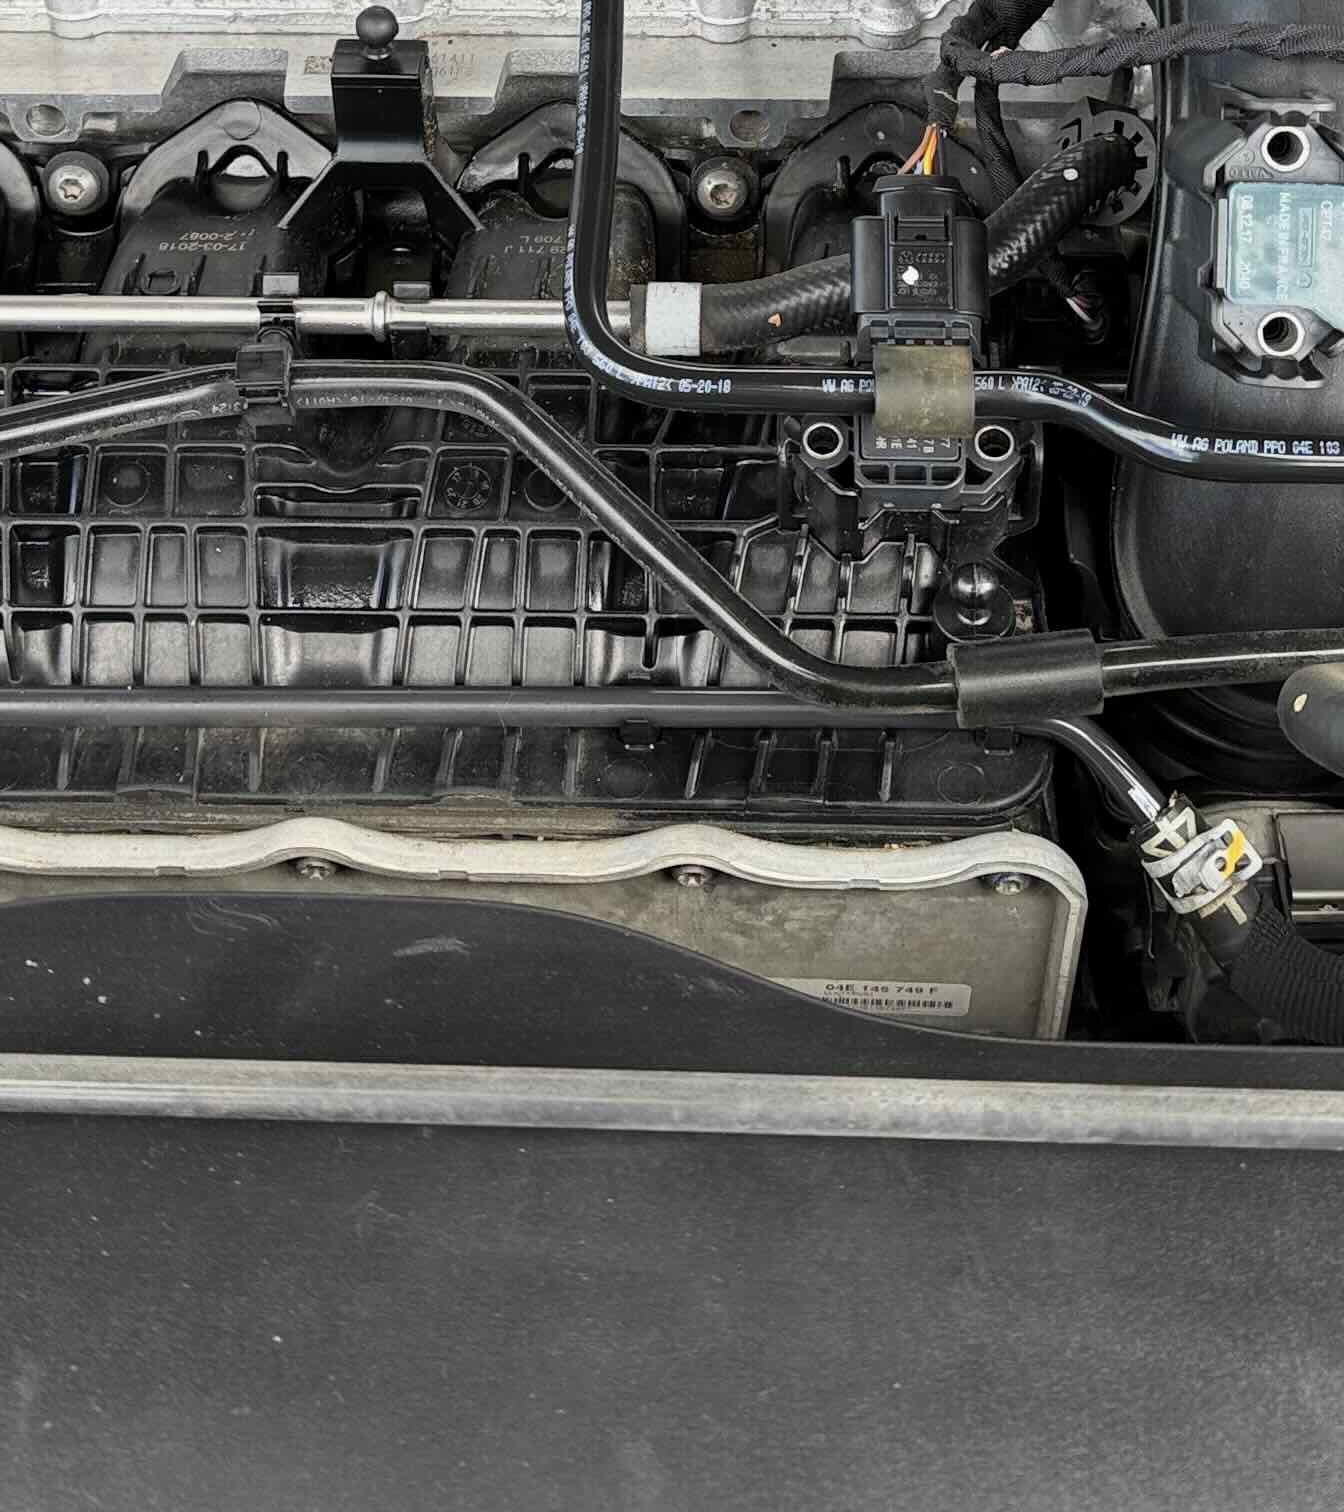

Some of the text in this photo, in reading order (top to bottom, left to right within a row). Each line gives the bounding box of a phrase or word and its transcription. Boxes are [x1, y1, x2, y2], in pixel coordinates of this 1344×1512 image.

[1278, 192, 1292, 230] MADE
[1276, 247, 1289, 301] FRANCE
[677, 378, 732, 394] 05-20-18
[822, 378, 835, 393] VW
[840, 378, 855, 393] AG
[998, 377, 1006, 391] L
[1214, 438, 1258, 454] POLAND
[825, 983, 855, 992] 04E
